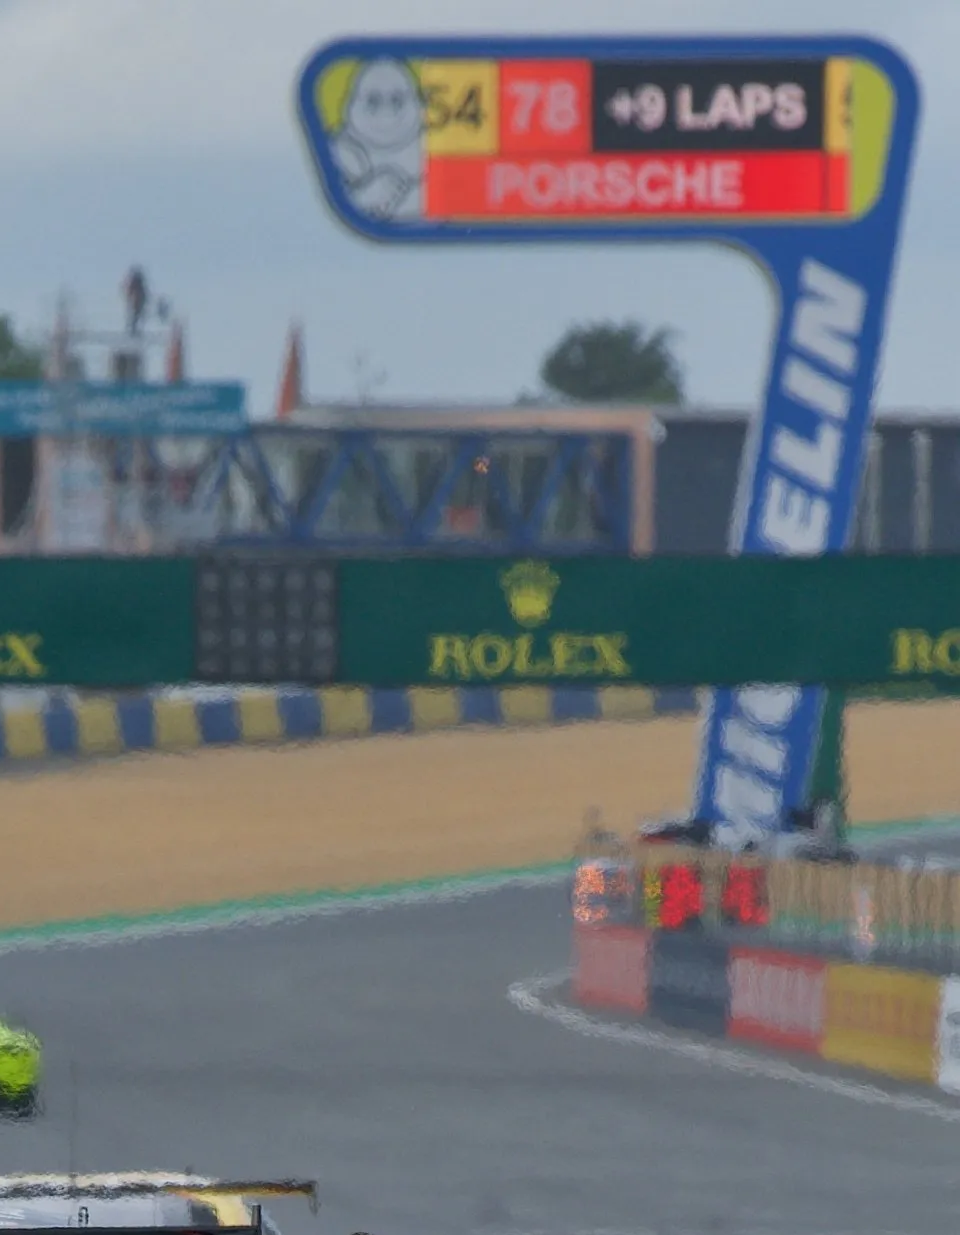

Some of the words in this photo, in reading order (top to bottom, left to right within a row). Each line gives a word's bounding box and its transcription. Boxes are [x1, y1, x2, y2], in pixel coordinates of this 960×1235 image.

[506, 80, 580, 134] 78
[607, 84, 667, 131] +9
[678, 82, 808, 131] LAPS
[486, 160, 746, 210] PORSCHE
[428, 632, 632, 681] ROLEX
